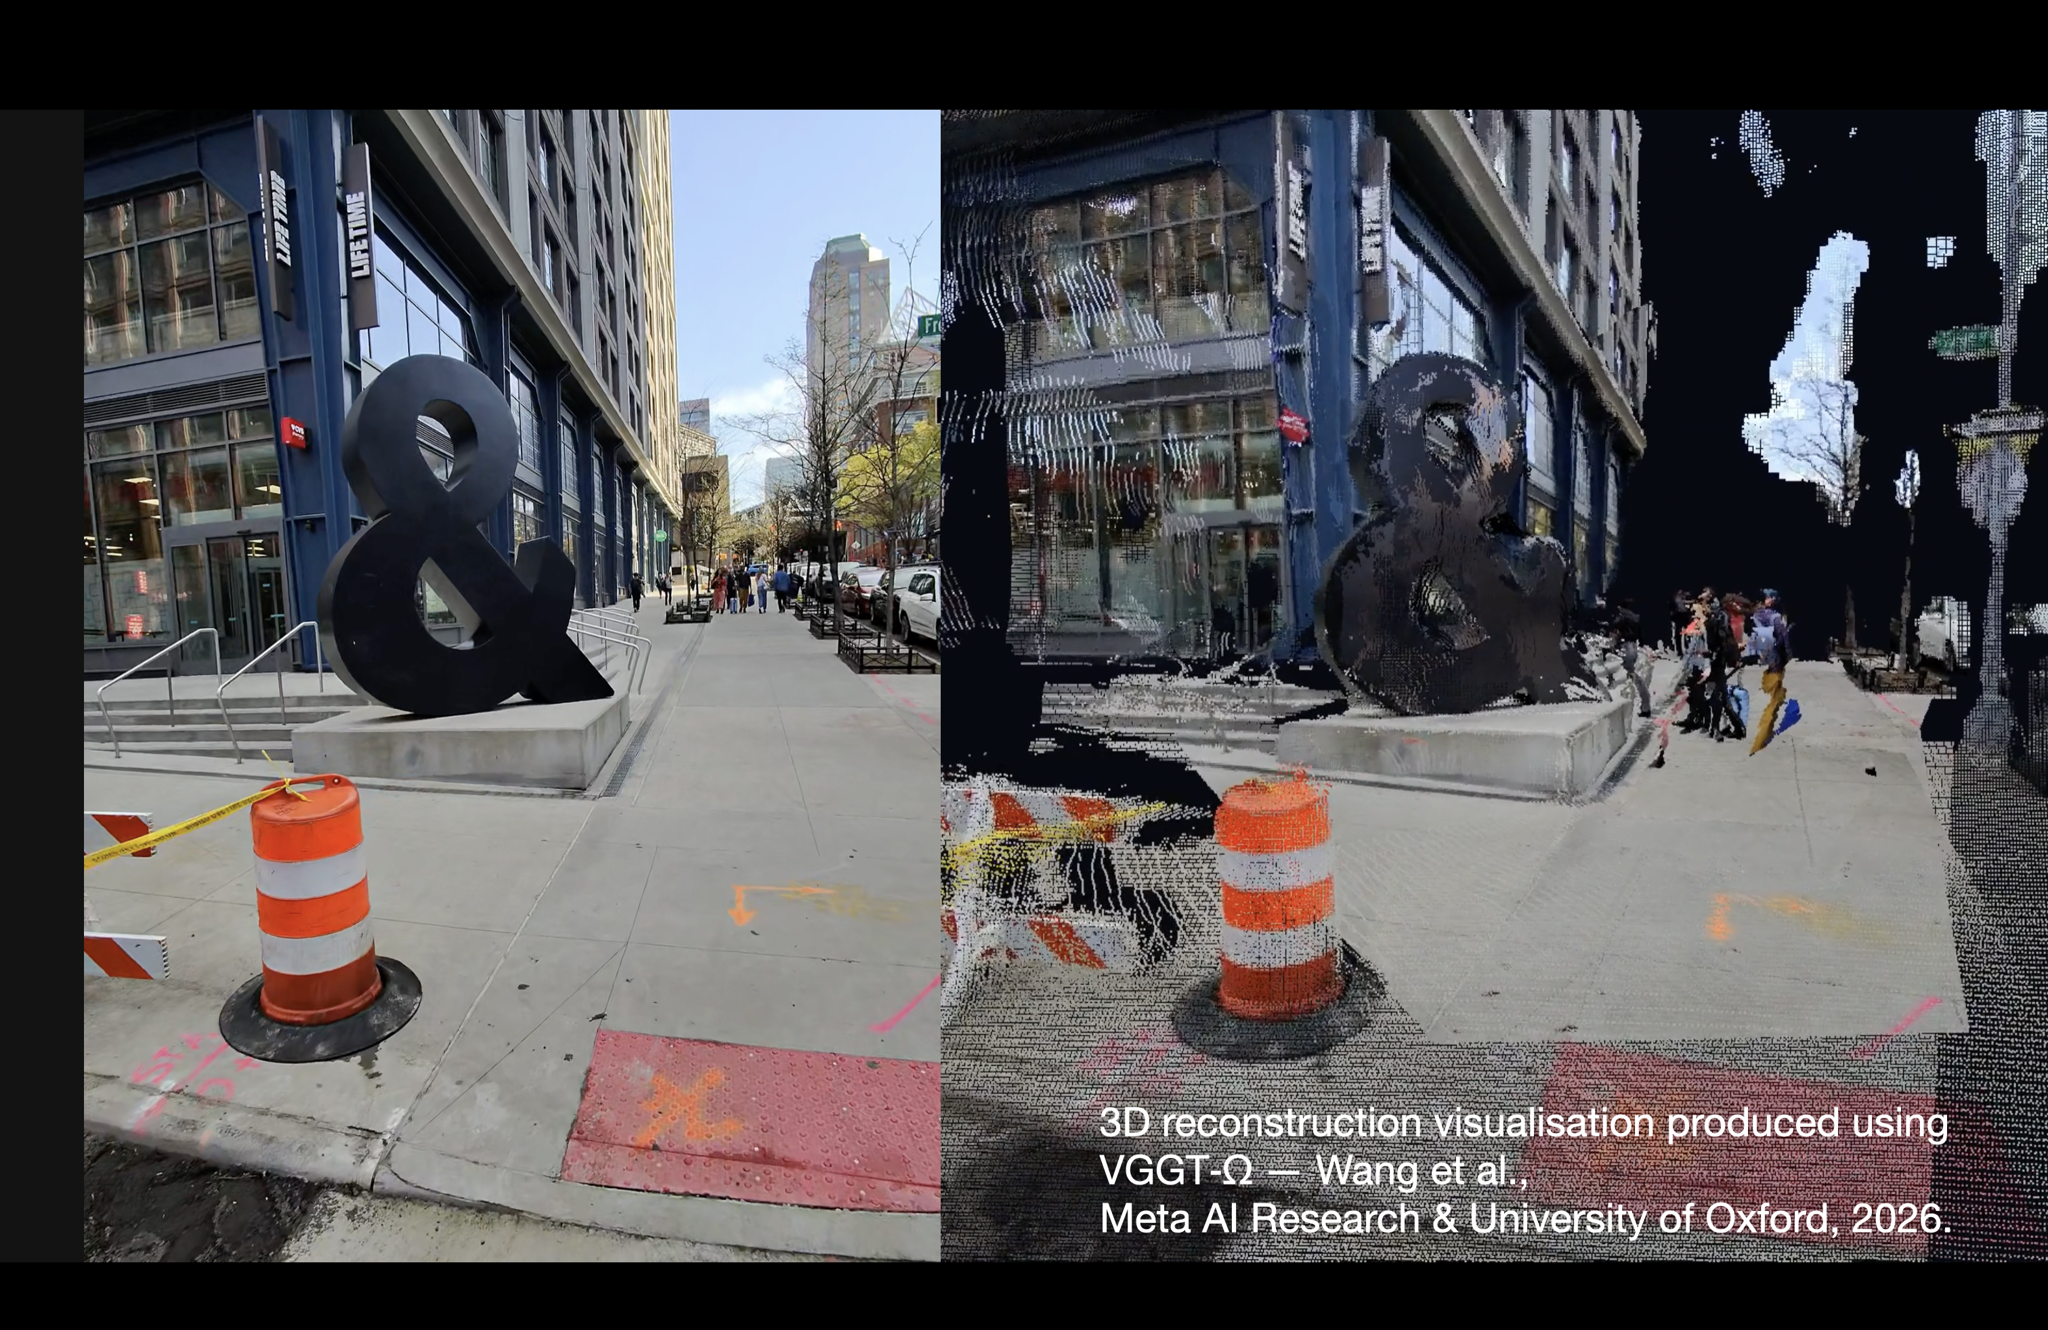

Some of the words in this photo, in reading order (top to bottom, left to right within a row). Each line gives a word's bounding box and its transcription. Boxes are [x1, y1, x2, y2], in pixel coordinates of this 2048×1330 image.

[270, 170, 288, 224] TIME
[346, 191, 367, 240] TIME
[274, 221, 291, 267] LIFE
[349, 239, 370, 278] LIFE
[318, 354, 614, 716] &
